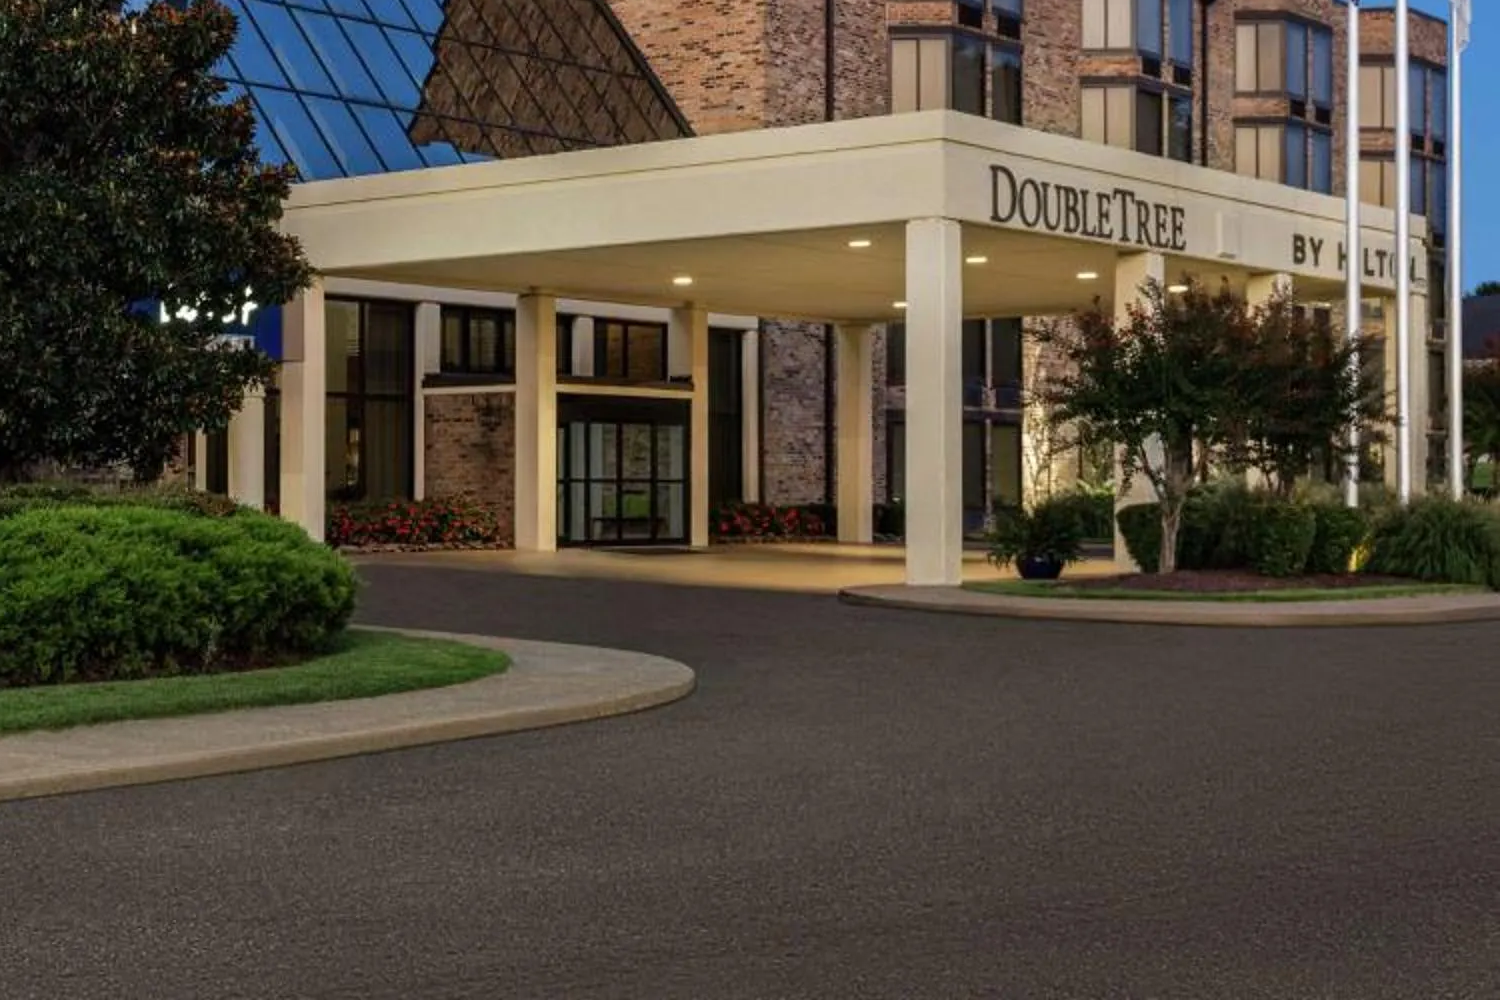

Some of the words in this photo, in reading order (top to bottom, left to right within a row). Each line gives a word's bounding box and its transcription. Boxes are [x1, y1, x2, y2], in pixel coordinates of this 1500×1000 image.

[990, 164, 1187, 251] DOUBLETREE
[1293, 233, 1324, 267] BY
[1337, 240, 1417, 283] HLT
